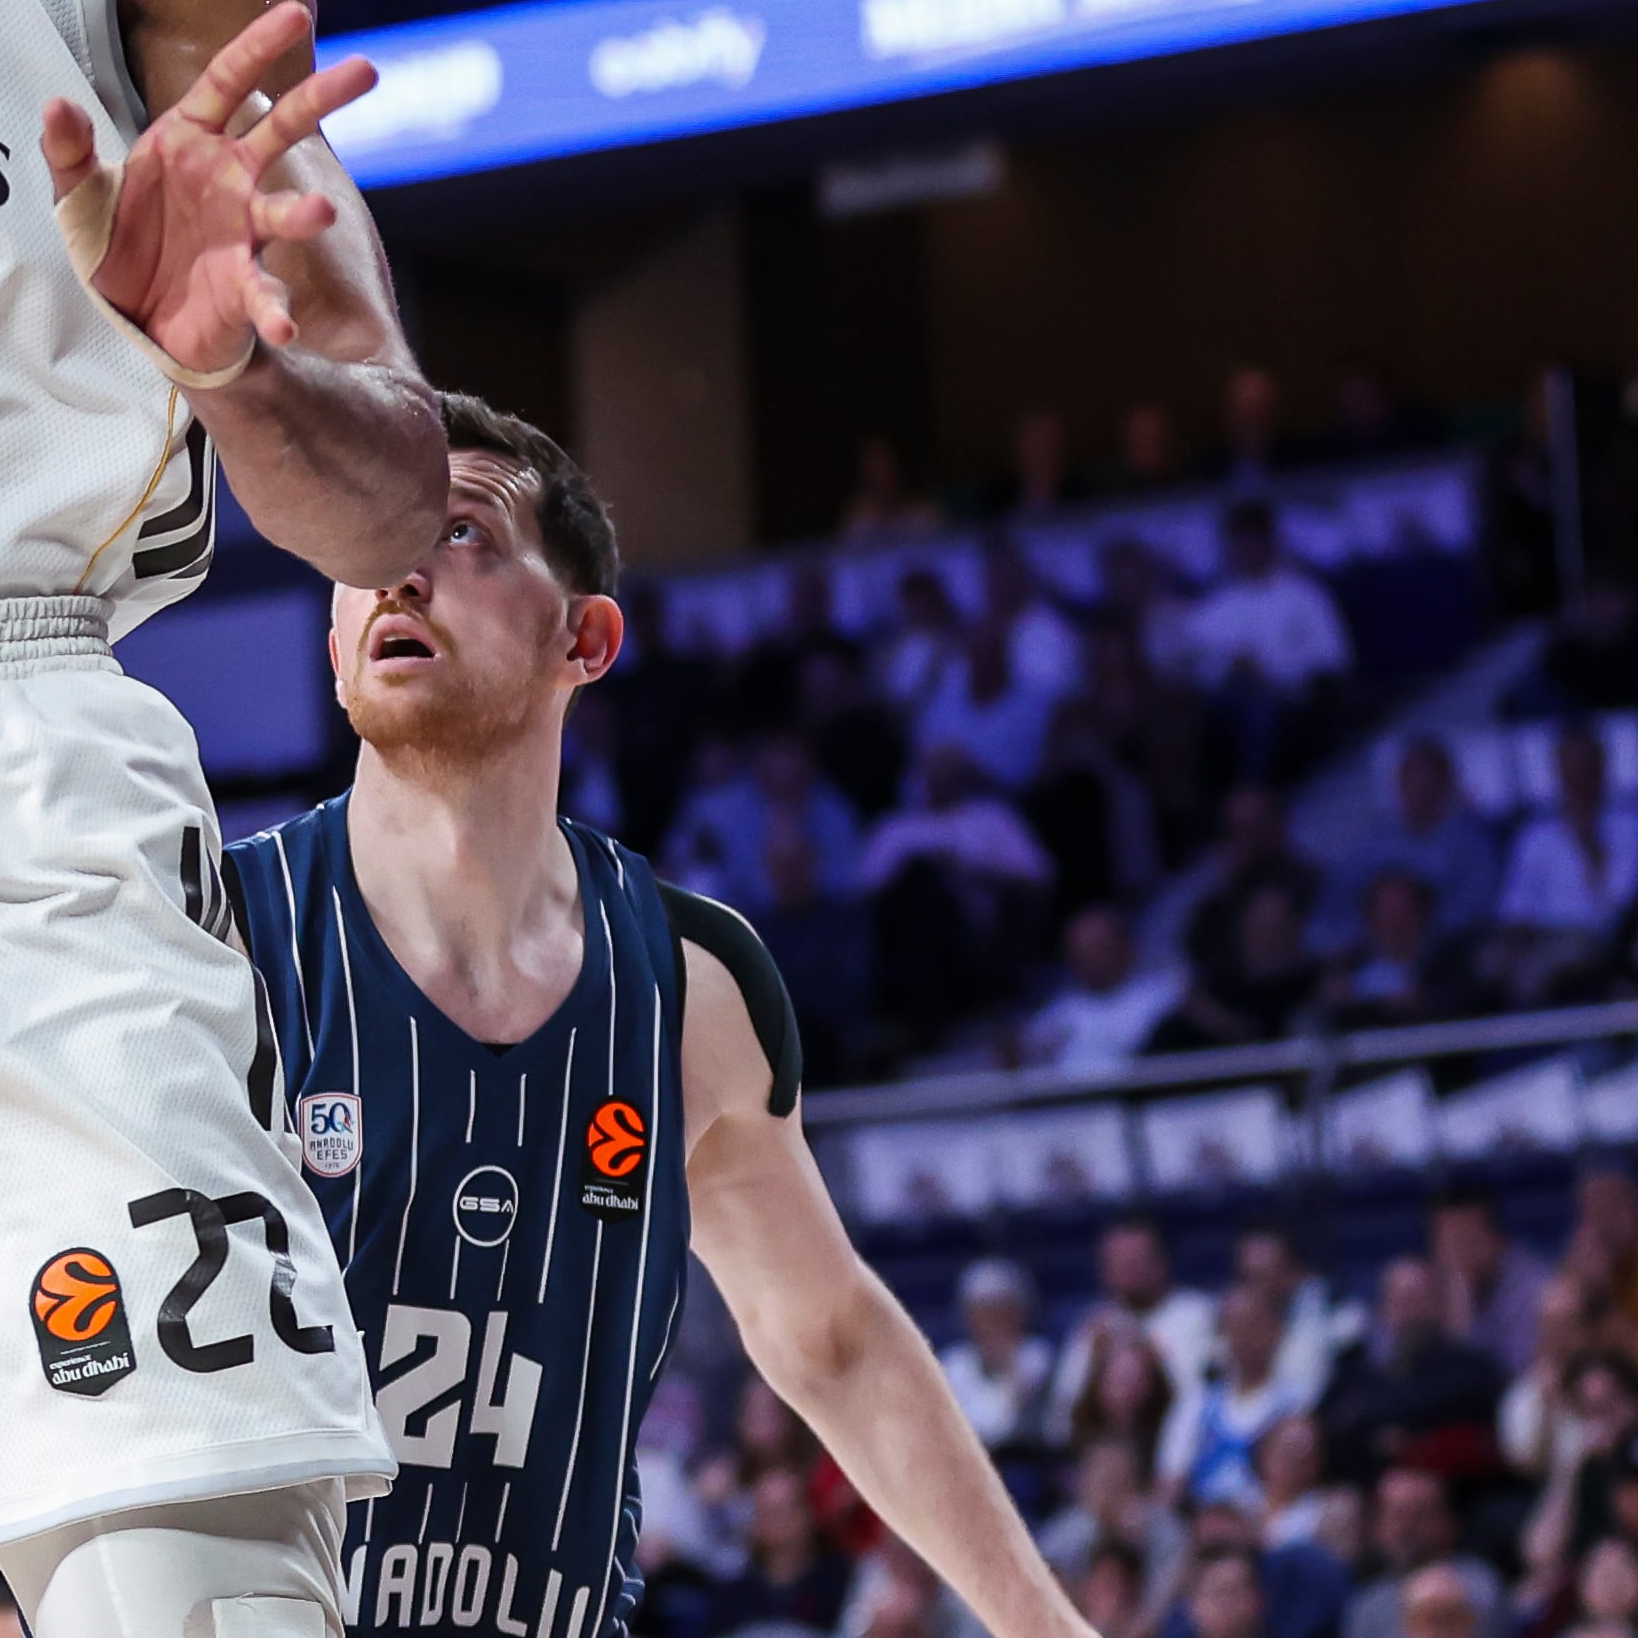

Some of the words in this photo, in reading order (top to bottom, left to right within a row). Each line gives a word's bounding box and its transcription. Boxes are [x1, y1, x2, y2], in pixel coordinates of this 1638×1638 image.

[316, 1149, 348, 1161] EFES
[459, 1196, 514, 1213] GSA
[582, 1192, 604, 1206] abu
[605, 1194, 640, 1211] dhabi
[52, 1368, 82, 1385] abu
[82, 1352, 130, 1378] dhabi
[375, 1304, 544, 1469] 24
[339, 1541, 591, 1638] NADOLU
